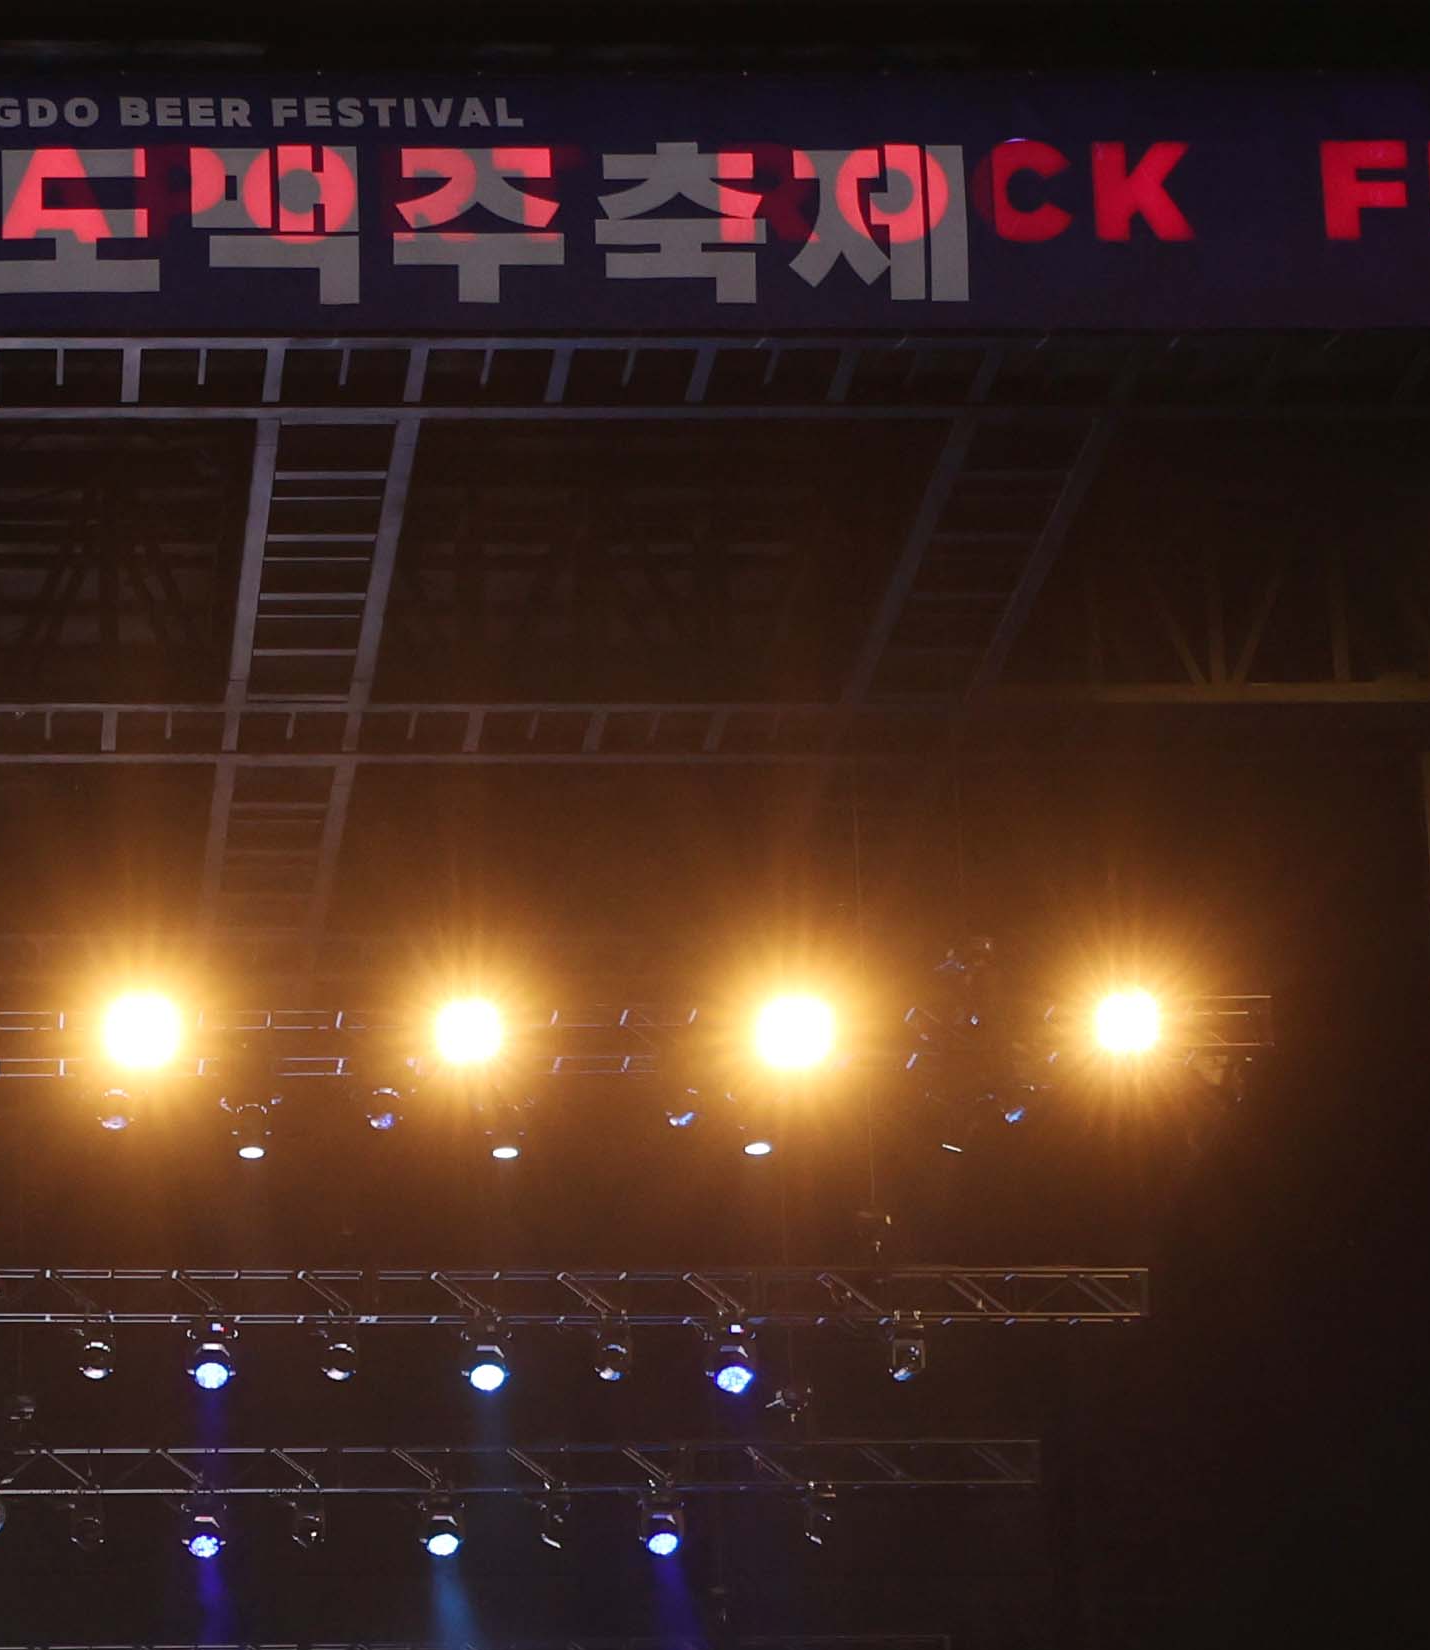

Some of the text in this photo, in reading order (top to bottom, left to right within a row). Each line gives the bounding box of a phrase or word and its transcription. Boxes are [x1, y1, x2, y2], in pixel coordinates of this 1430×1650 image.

[120, 96, 253, 128] BEER
[271, 96, 525, 128] FESTIVAL
[717, 138, 1196, 244] ROCK
